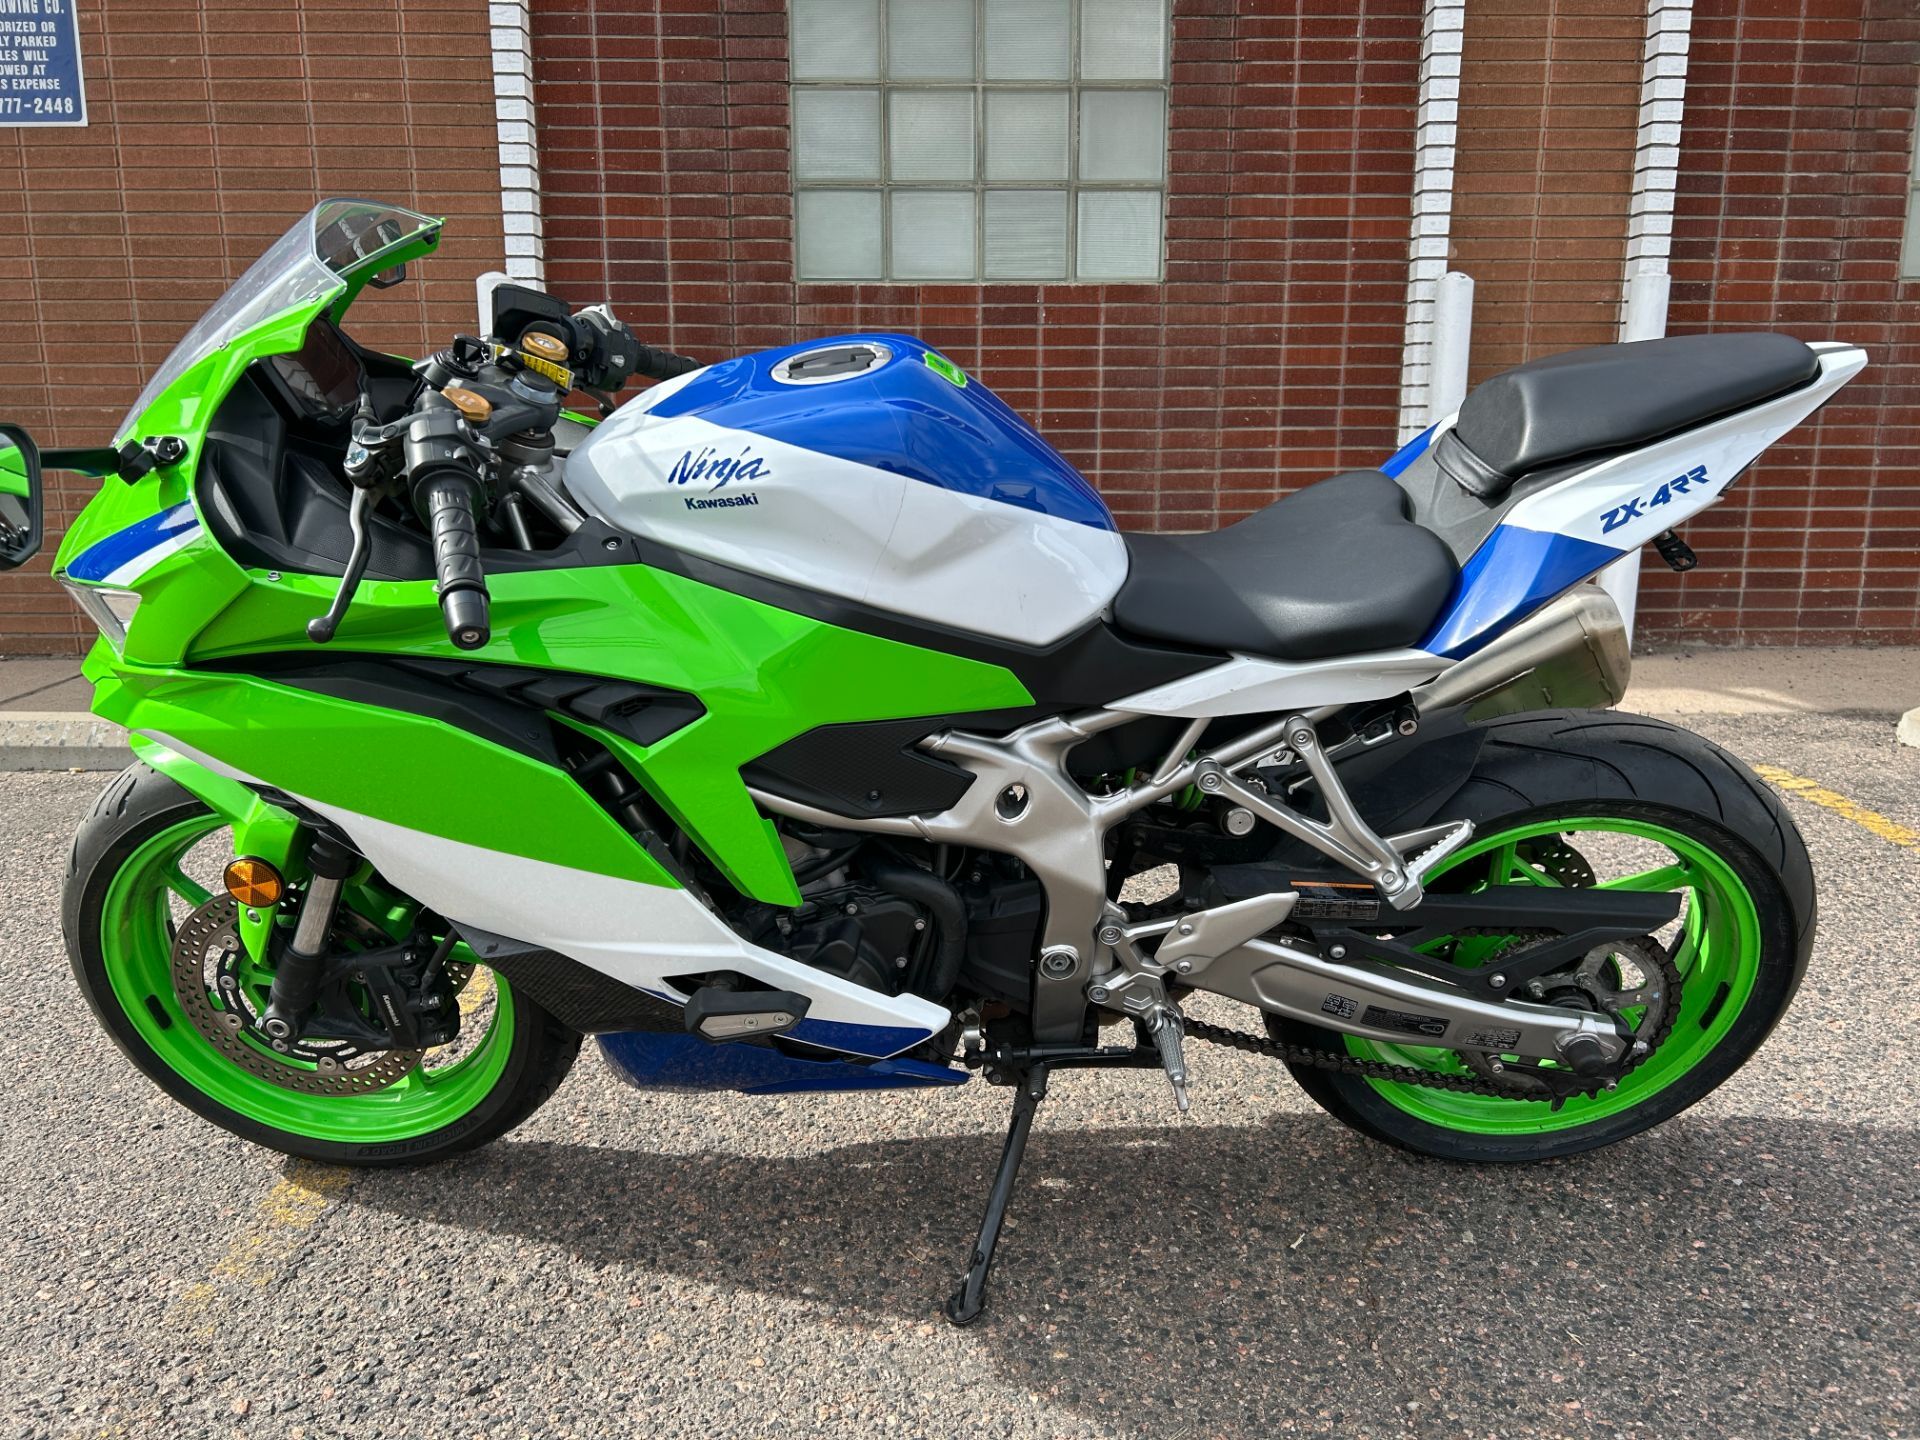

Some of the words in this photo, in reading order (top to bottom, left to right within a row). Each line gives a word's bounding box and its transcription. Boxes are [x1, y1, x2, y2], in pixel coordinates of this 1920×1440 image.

[45, 0, 64, 14] CO.
[41, 21, 56, 33] OR
[14, 36, 57, 47] PARKED
[23, 50, 49, 61] WILL
[33, 64, 46, 76] AT
[12, 78, 60, 90] EXPENSE
[667, 446, 771, 494] Ninja
[684, 492, 759, 510] Kawasaki
[1600, 464, 1710, 535] ZX-4RR
